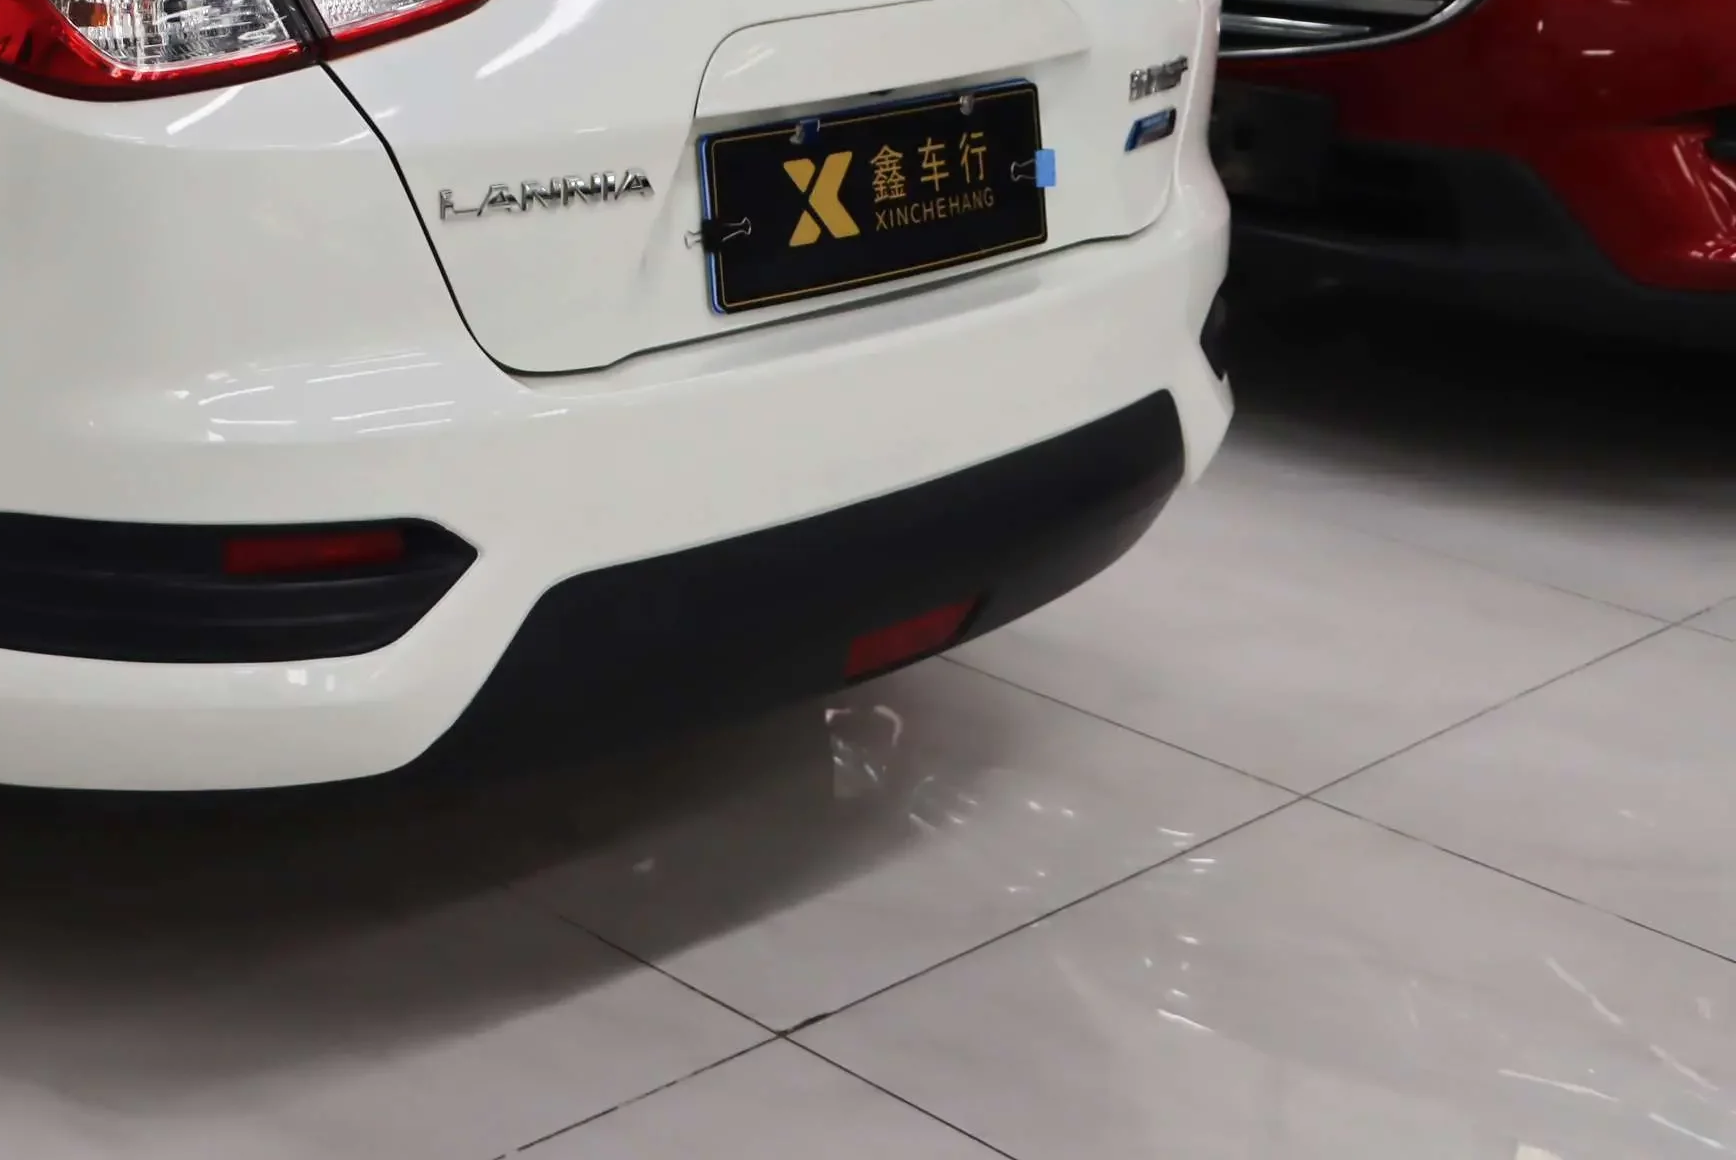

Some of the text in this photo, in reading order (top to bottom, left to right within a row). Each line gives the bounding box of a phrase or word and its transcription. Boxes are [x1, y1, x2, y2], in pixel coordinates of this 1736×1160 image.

[439, 167, 655, 220] LANNIA
[870, 131, 987, 203] 鑫车行
[875, 186, 995, 231] XINCHEHANG
